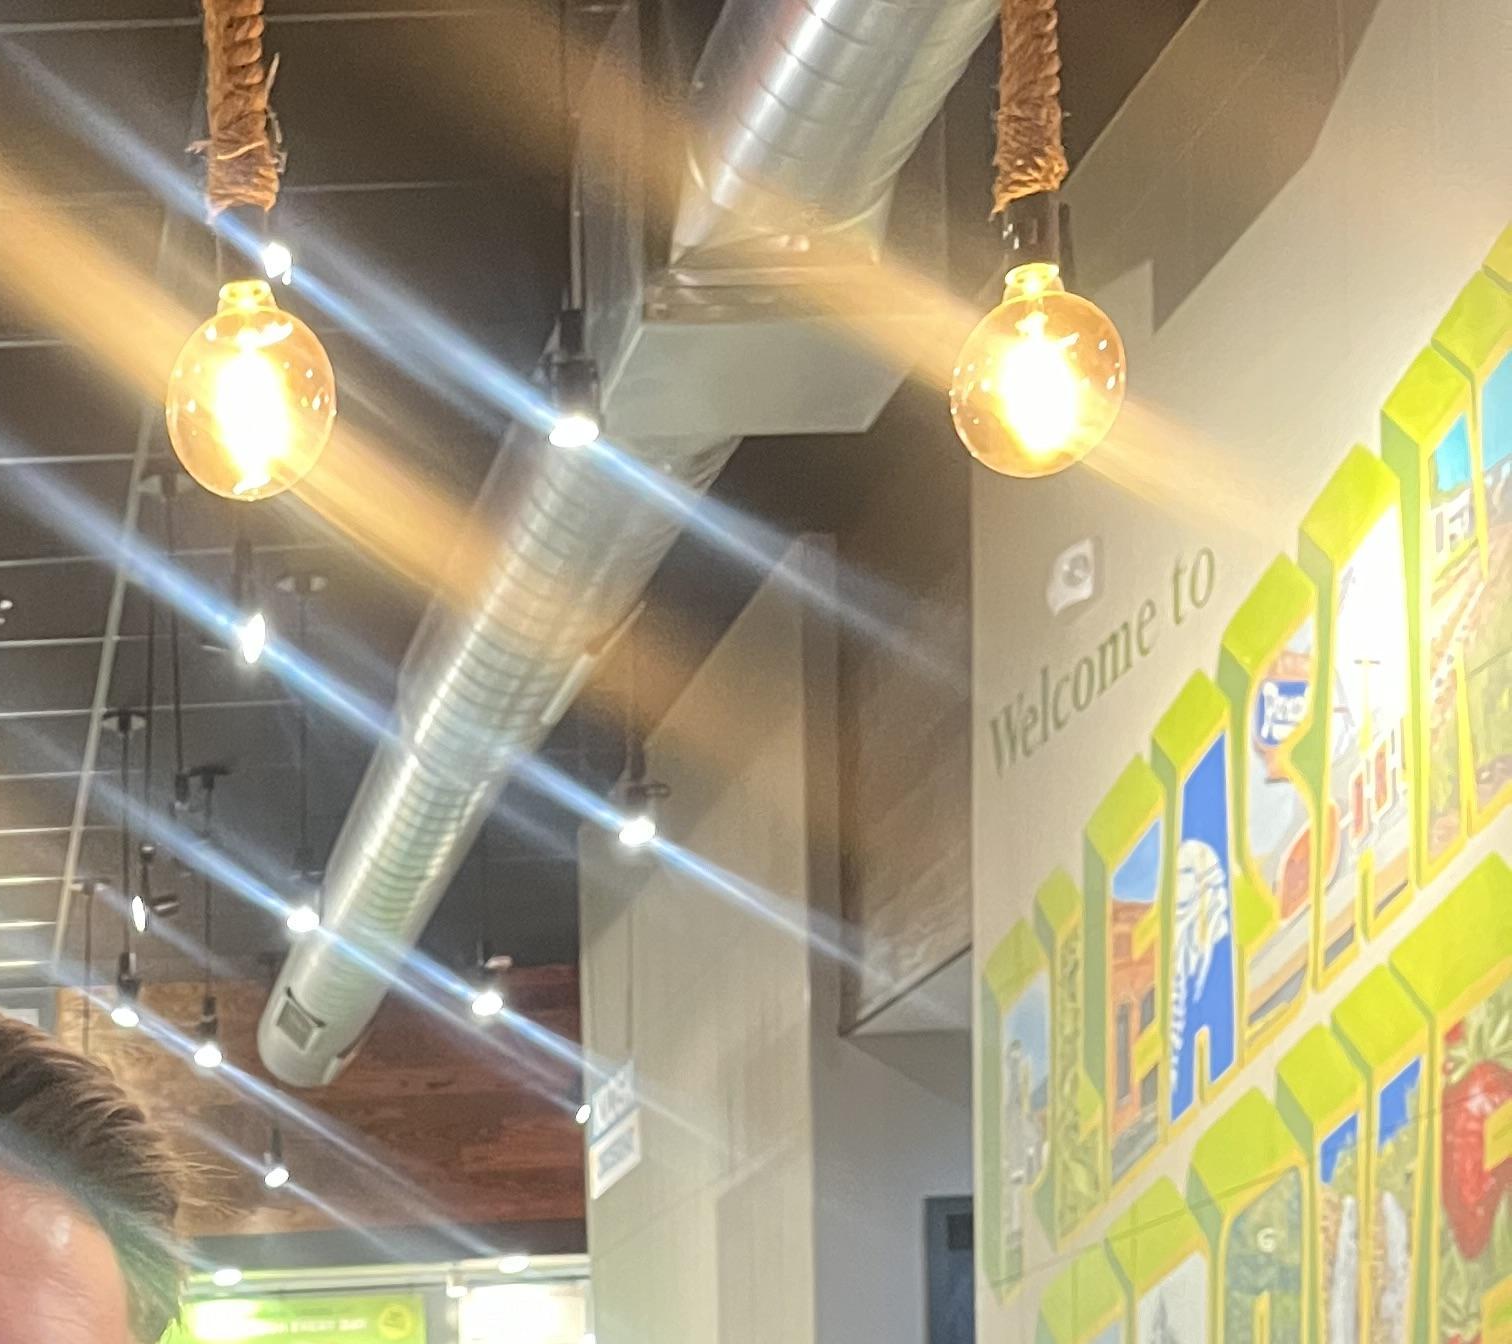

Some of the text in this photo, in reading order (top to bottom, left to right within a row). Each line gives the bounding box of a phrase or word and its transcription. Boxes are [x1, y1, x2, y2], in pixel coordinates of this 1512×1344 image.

[982, 218, 1512, 1307] PLEASAN
[989, 597, 1157, 780] Welcome
[1173, 546, 1216, 627] to
